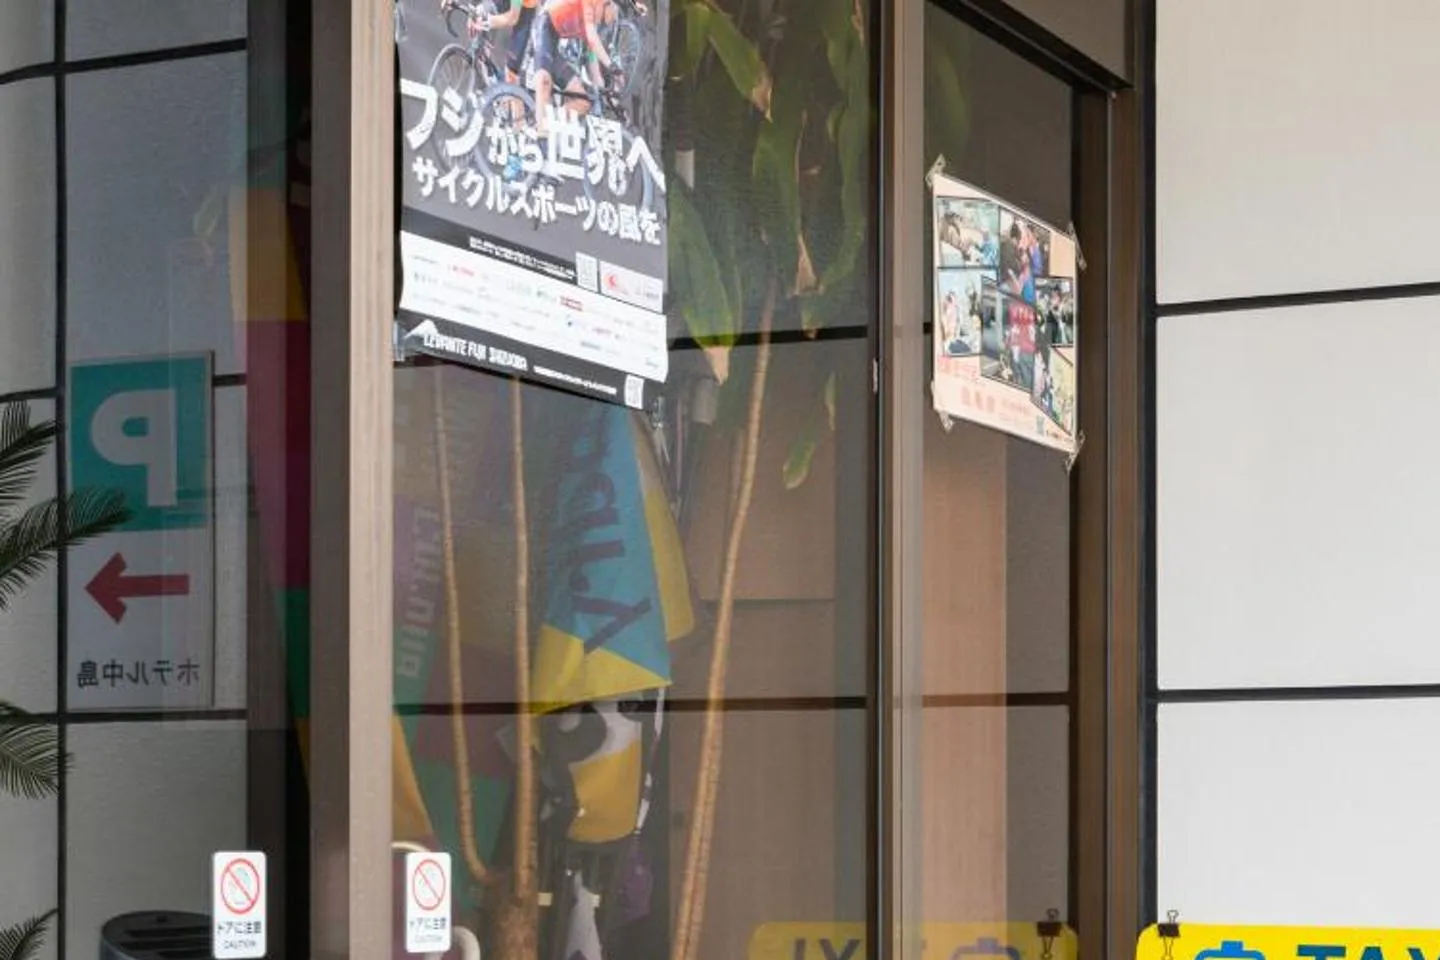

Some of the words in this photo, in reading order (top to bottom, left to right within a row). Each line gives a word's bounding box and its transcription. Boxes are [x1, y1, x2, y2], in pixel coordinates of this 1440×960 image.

[400, 78, 666, 197] フジから世界へ
